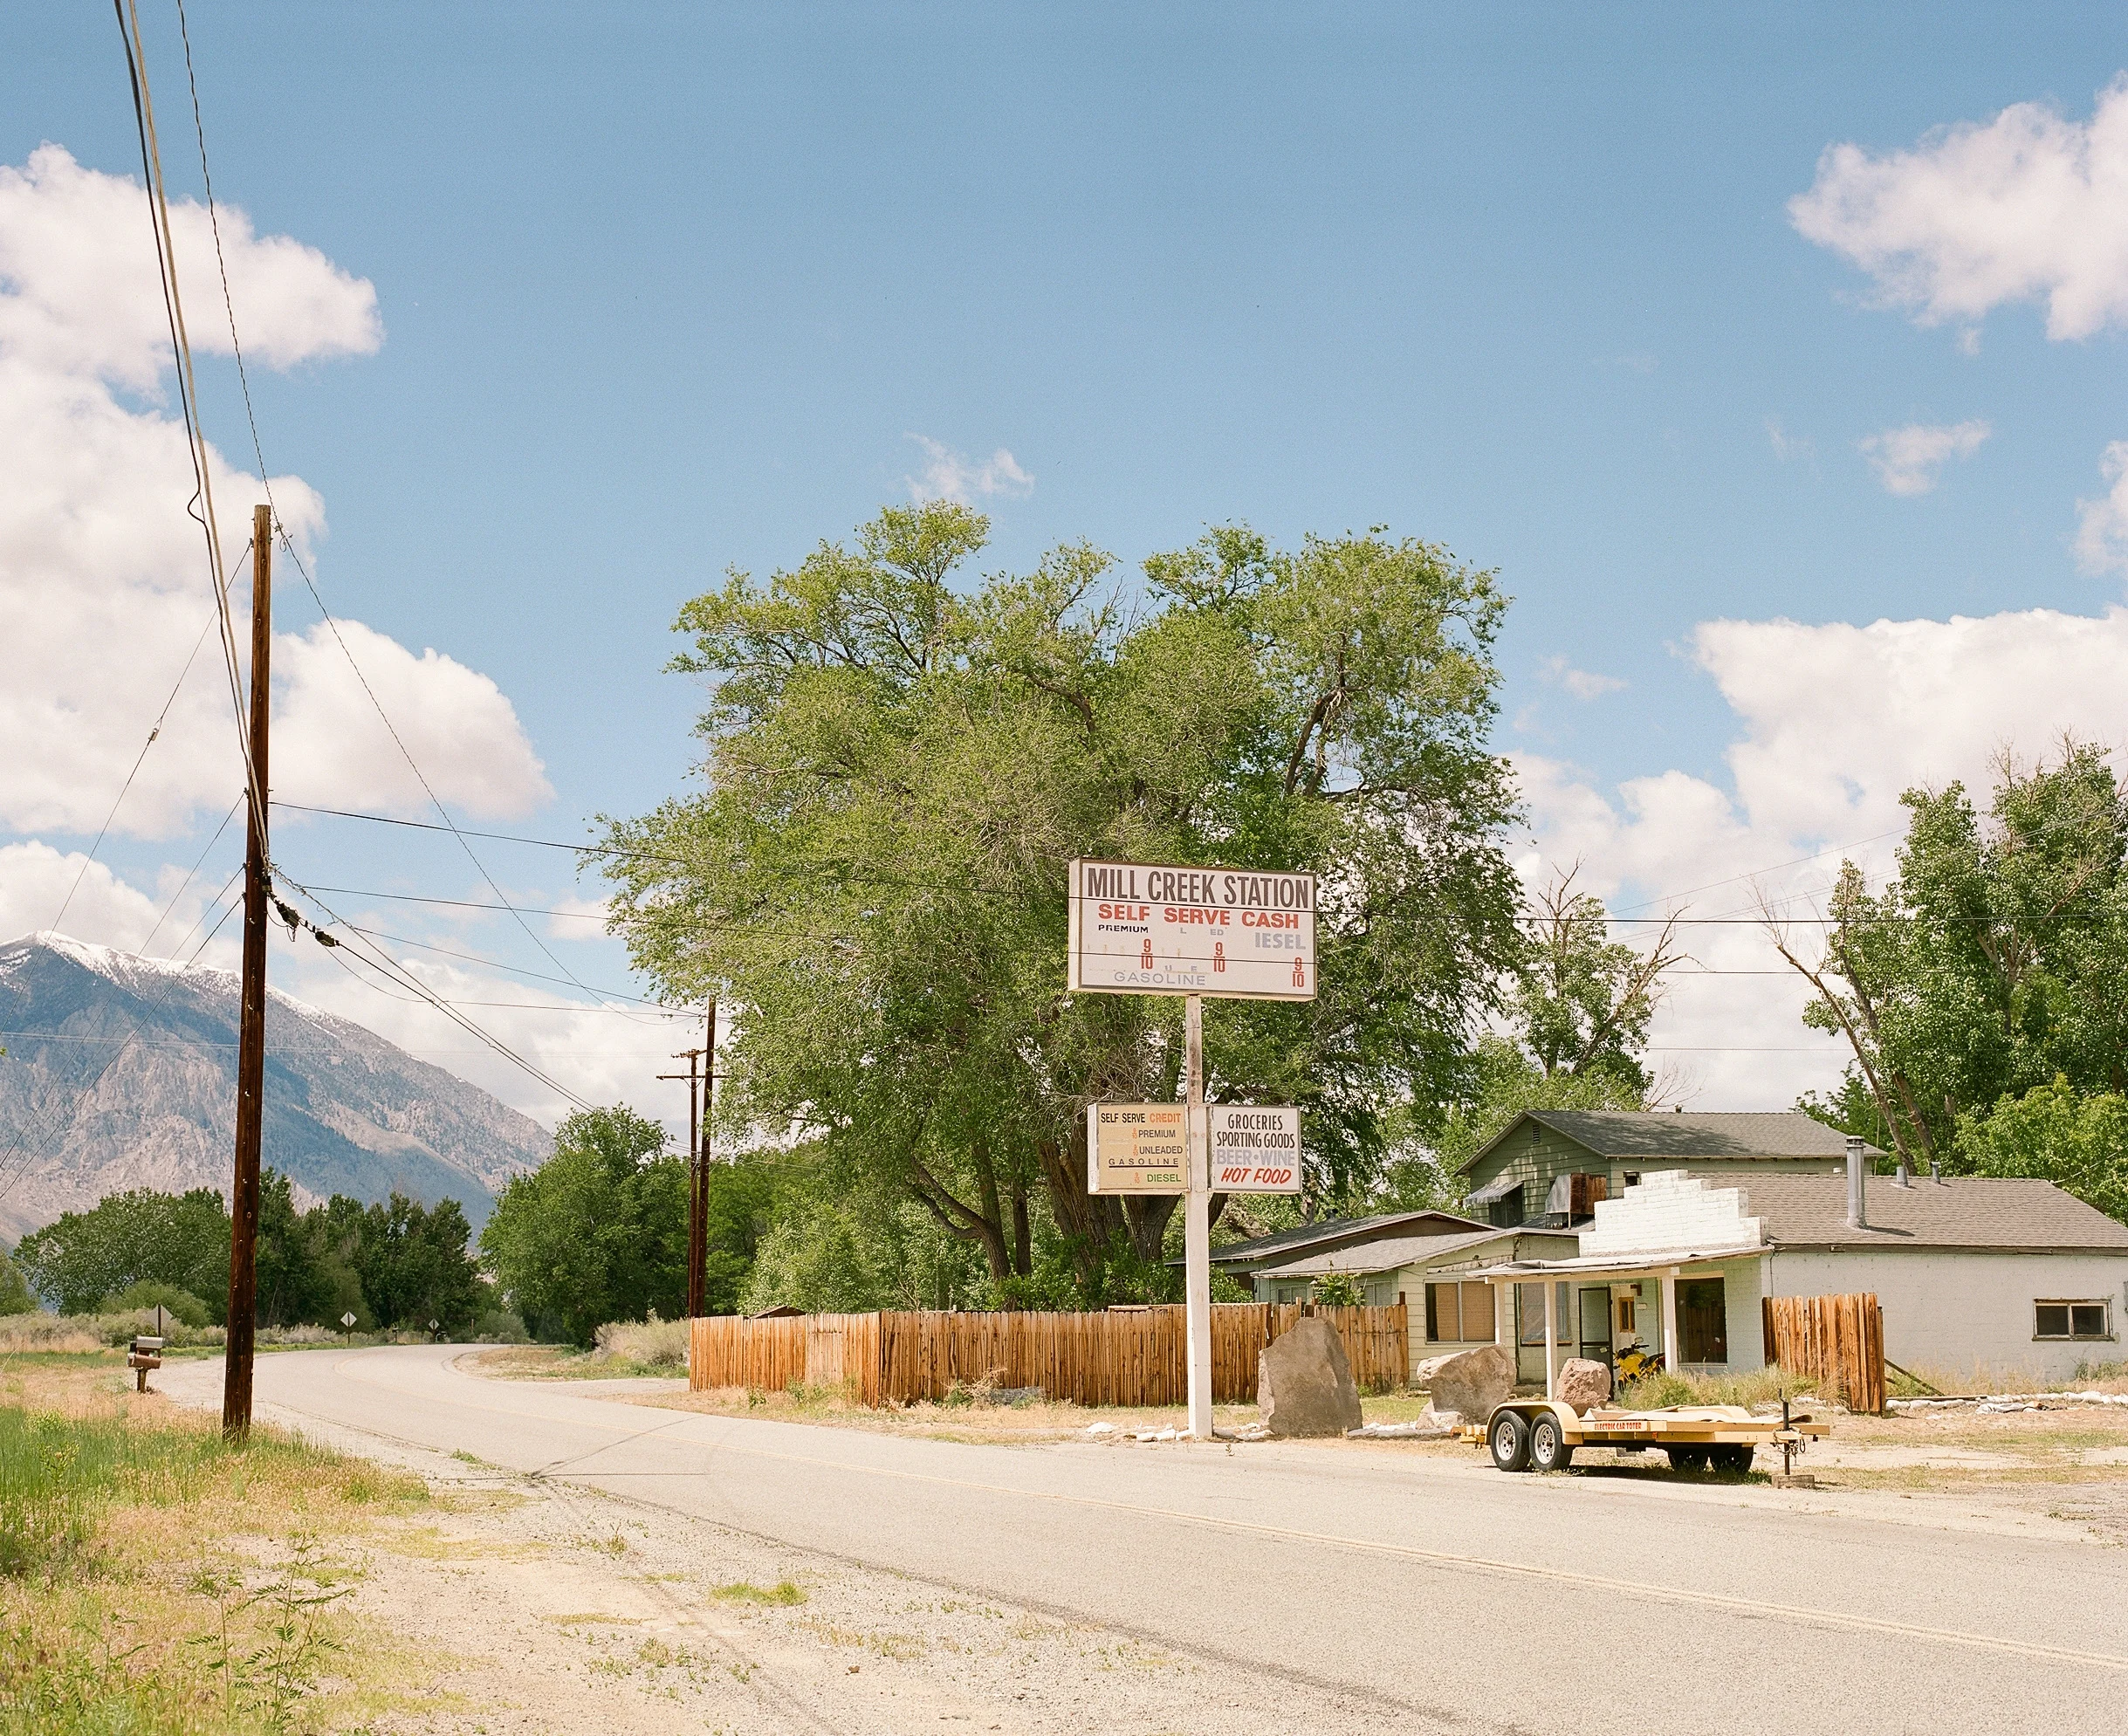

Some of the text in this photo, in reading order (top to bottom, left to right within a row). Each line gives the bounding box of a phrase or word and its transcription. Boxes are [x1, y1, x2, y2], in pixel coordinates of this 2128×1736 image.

[1088, 868, 1308, 909] MILL CREEK STATION
[1098, 903, 1299, 929] SELF SERVE CASH
[1098, 924, 1149, 933] PREMIUM
[1255, 932, 1306, 950] IESEL
[1115, 971, 1205, 985] GASOLINE
[1101, 1113, 1181, 1123] SELF SERVE CREDIT
[1228, 1114, 1283, 1130] GROCERIES
[1138, 1129, 1176, 1138] PREMIUM
[1217, 1131, 1295, 1149] SPORTING GOODS
[1139, 1146, 1183, 1155] UNLEADED
[1221, 1167, 1292, 1184] HOT FOOD
